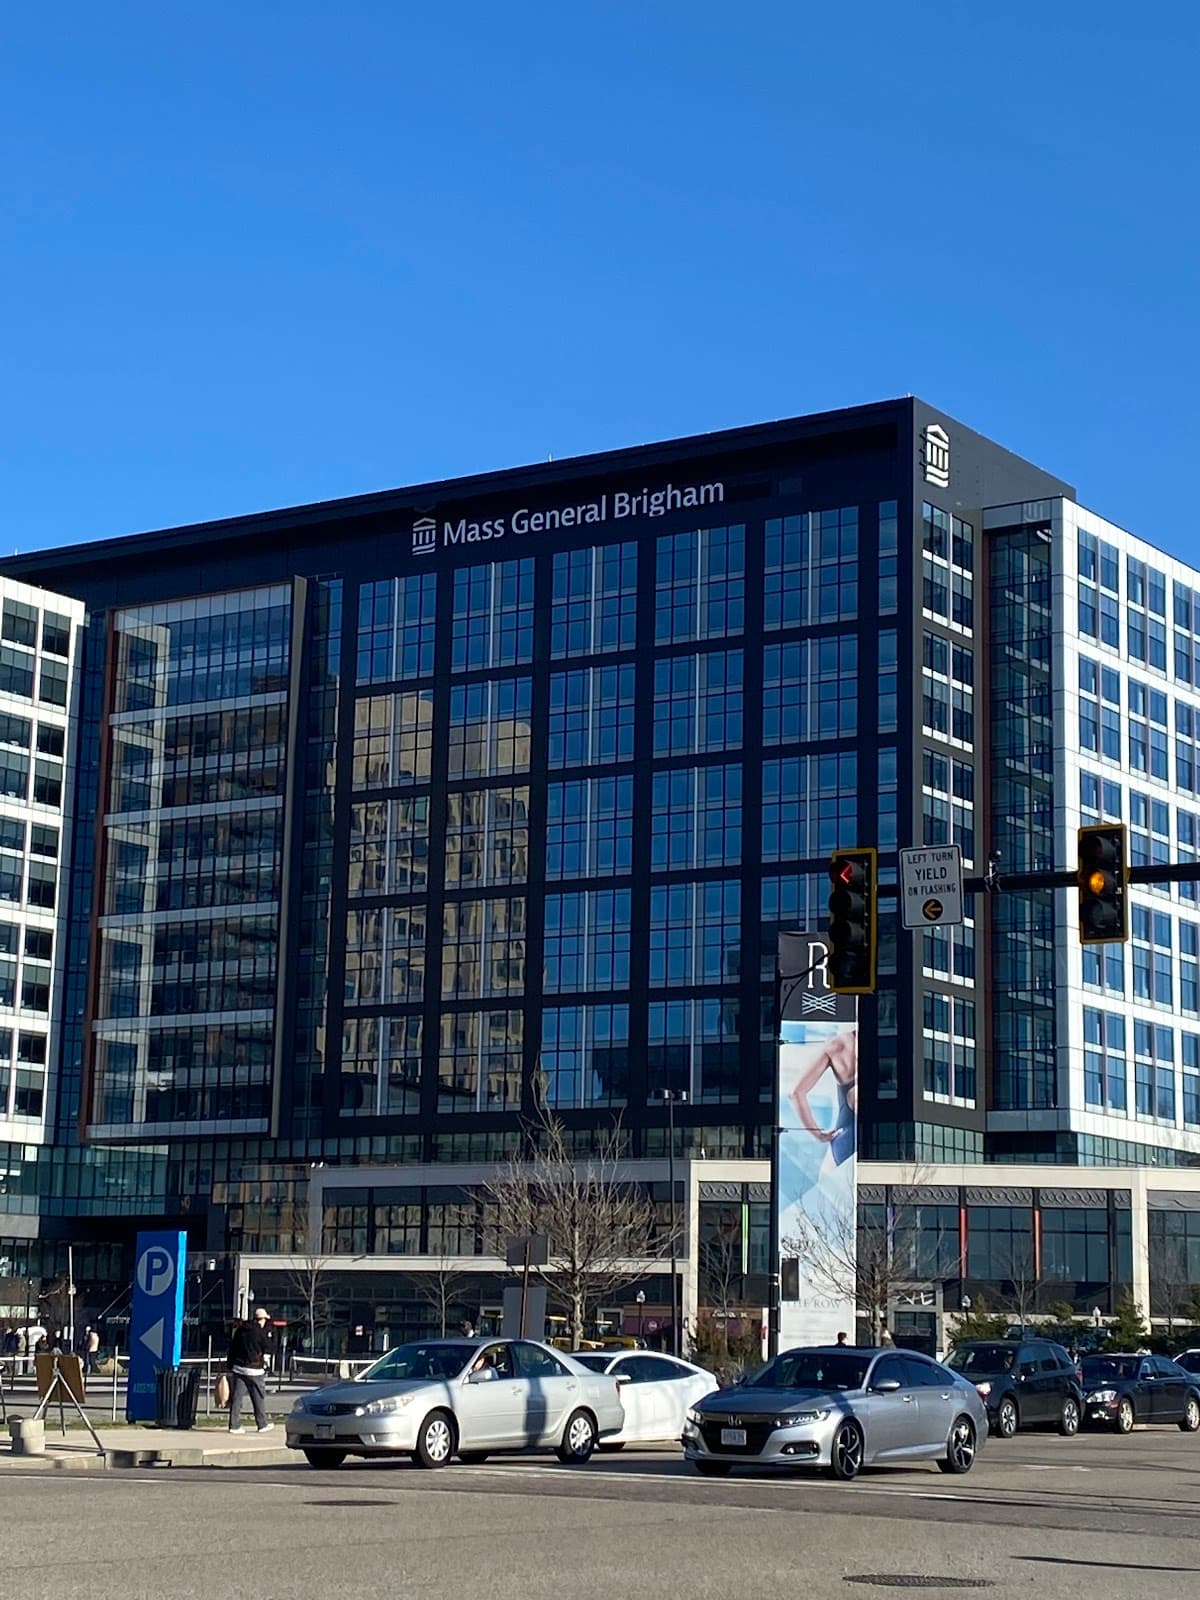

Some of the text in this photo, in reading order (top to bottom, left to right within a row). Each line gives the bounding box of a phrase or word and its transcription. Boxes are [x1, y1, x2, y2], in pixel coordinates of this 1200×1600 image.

[443, 482, 724, 546] Mass General Brigham
[907, 850, 953, 864] LEFT TURN
[915, 866, 947, 880] YIELD
[908, 882, 956, 897] ON FLASHING
[807, 941, 831, 989] R
[145, 1251, 169, 1291] P
